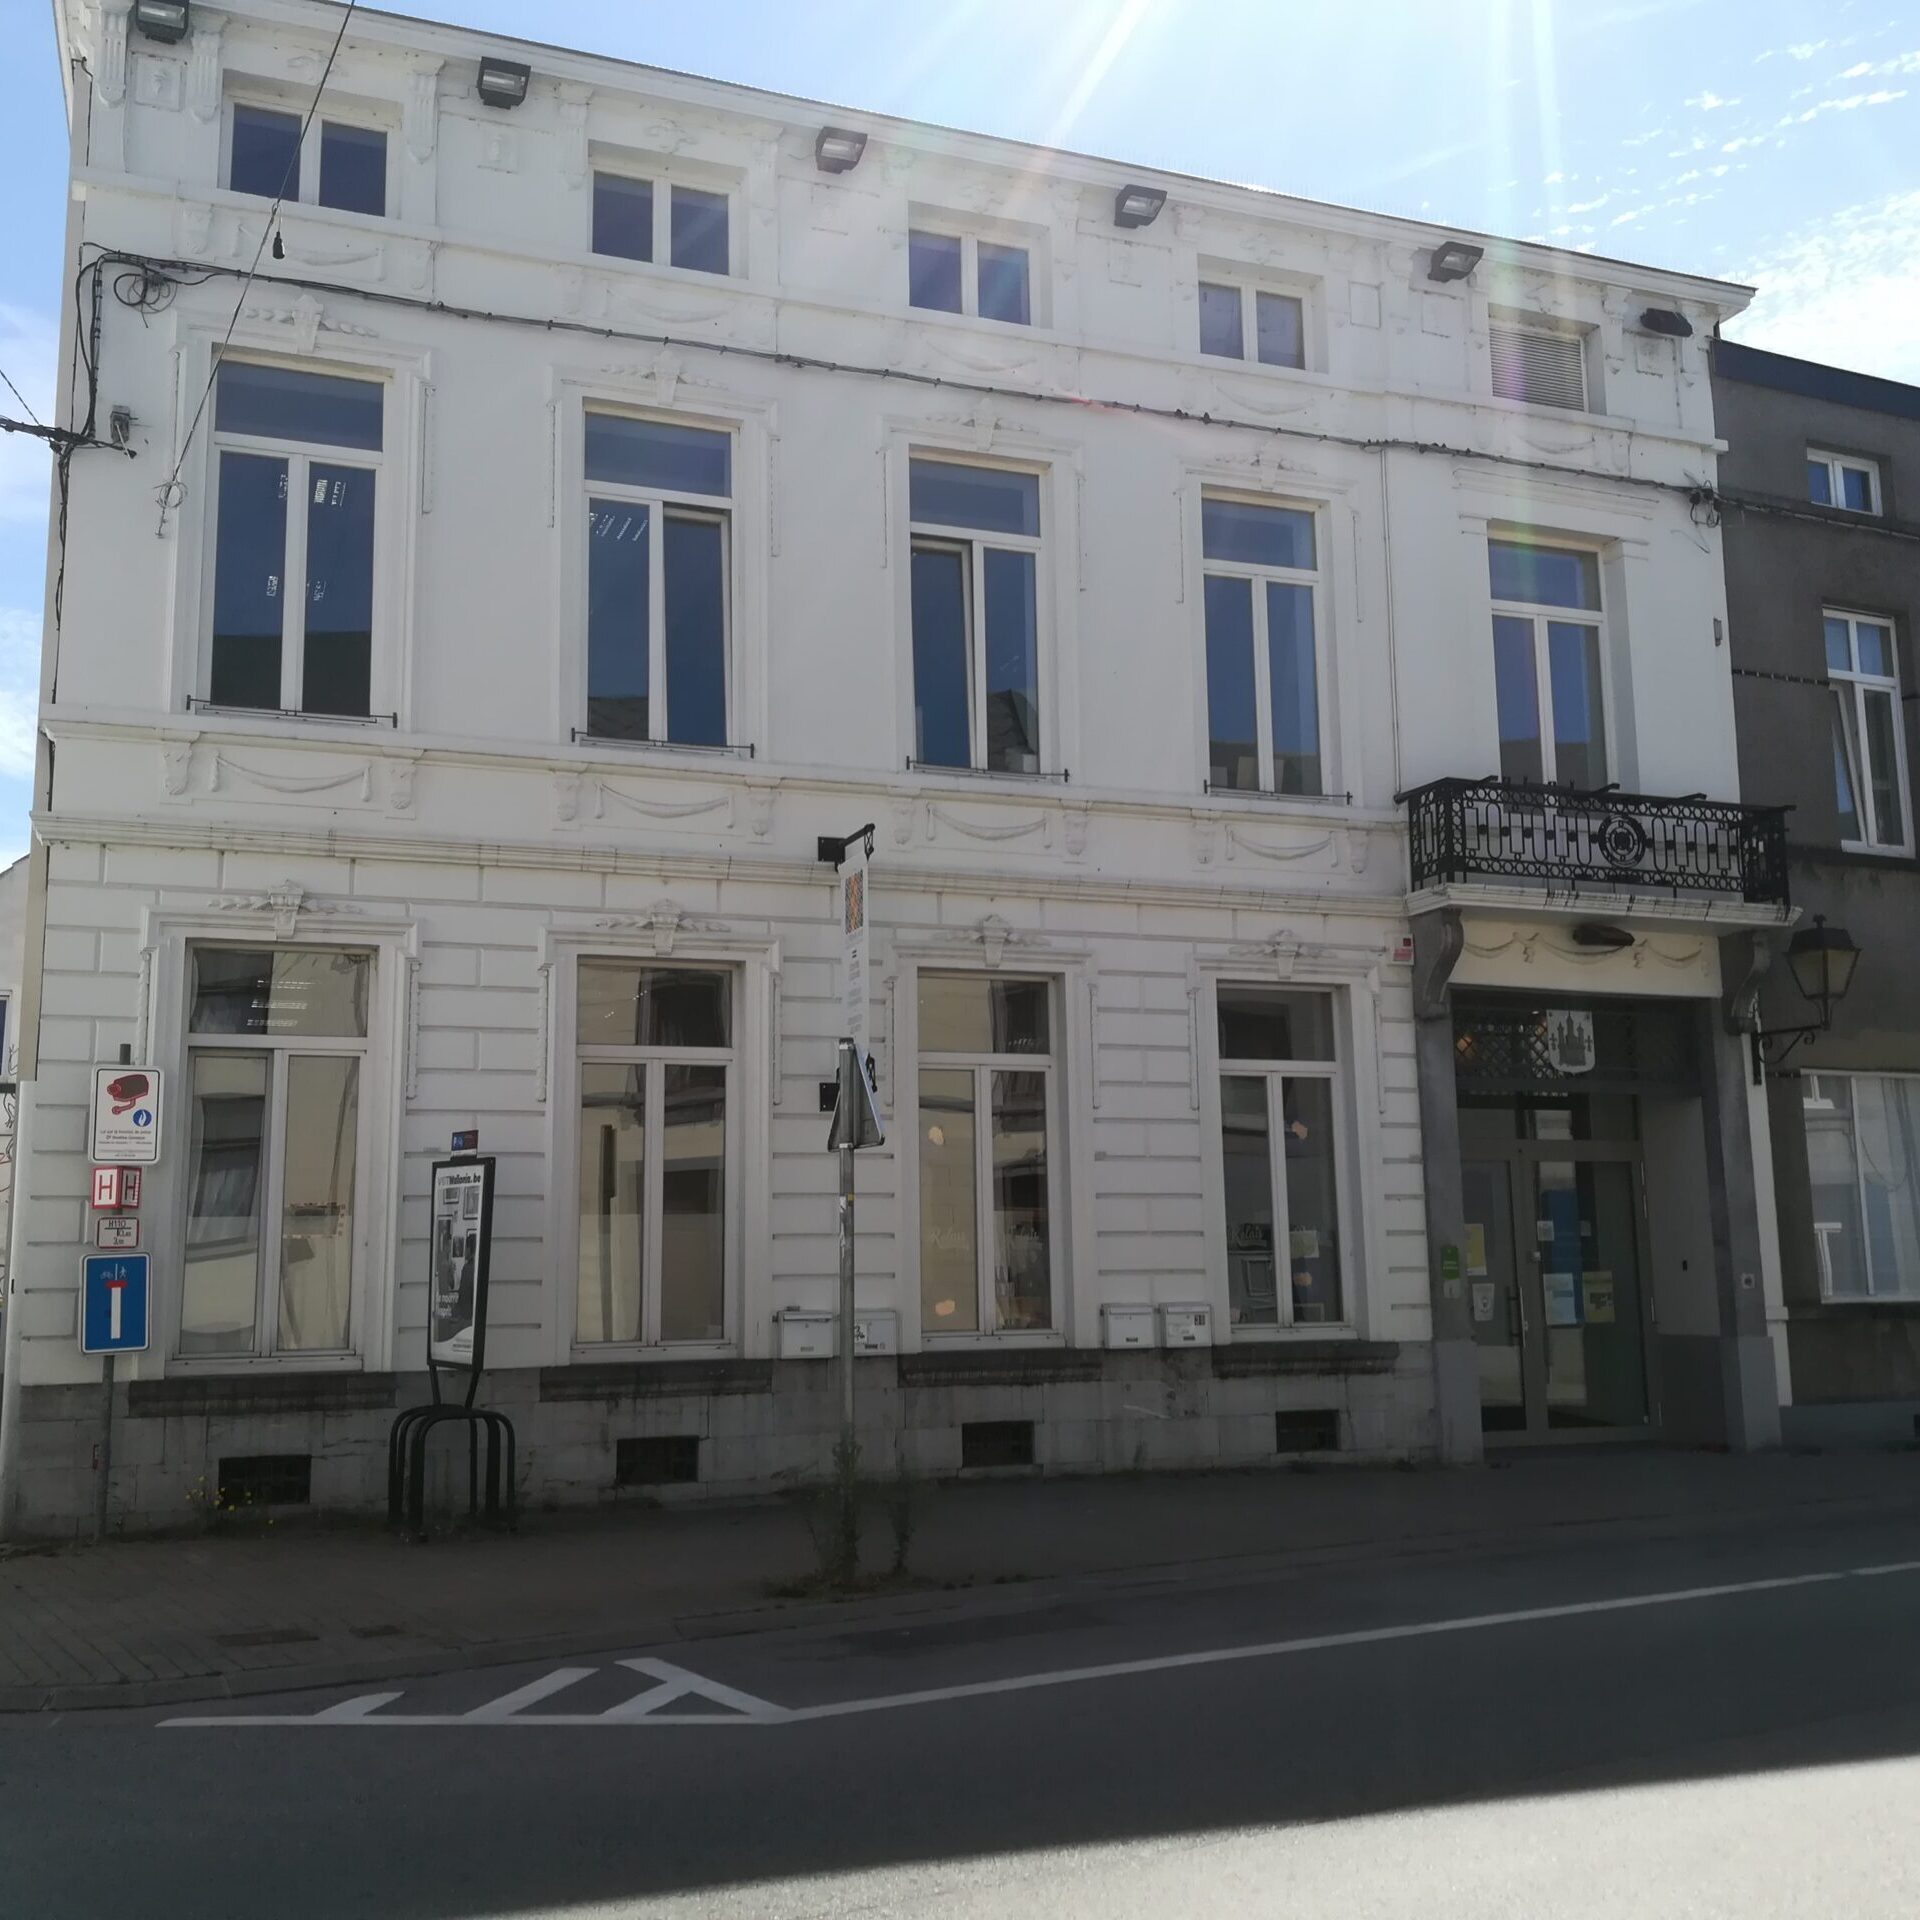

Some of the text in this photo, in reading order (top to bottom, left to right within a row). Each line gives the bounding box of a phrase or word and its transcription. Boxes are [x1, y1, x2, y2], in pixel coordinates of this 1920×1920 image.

[98, 1174, 137, 1200] H H
[108, 1219, 127, 1228] H110
